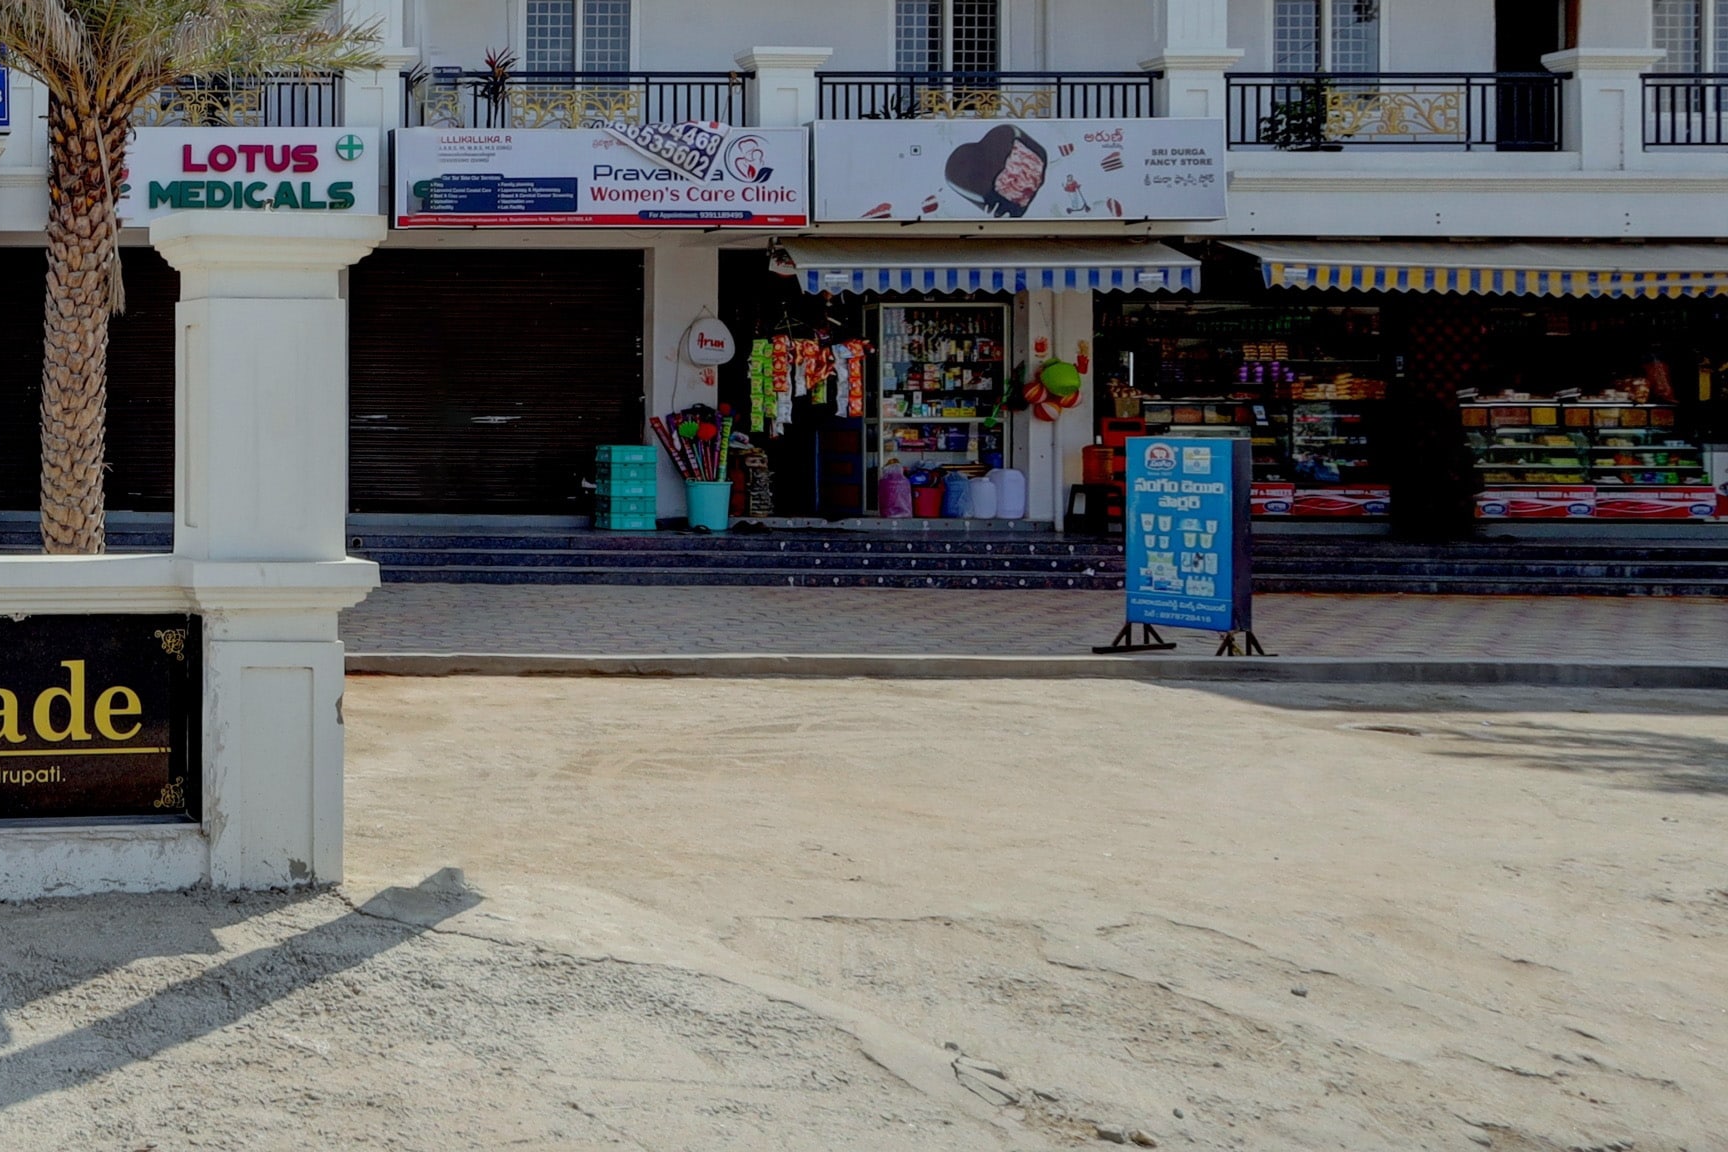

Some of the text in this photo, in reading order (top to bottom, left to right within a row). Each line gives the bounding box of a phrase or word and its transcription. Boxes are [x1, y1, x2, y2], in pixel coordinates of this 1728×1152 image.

[182, 144, 319, 173] LOTUS
[149, 181, 356, 209] MEDICALS
[590, 185, 797, 204] Women's Care Clinic
